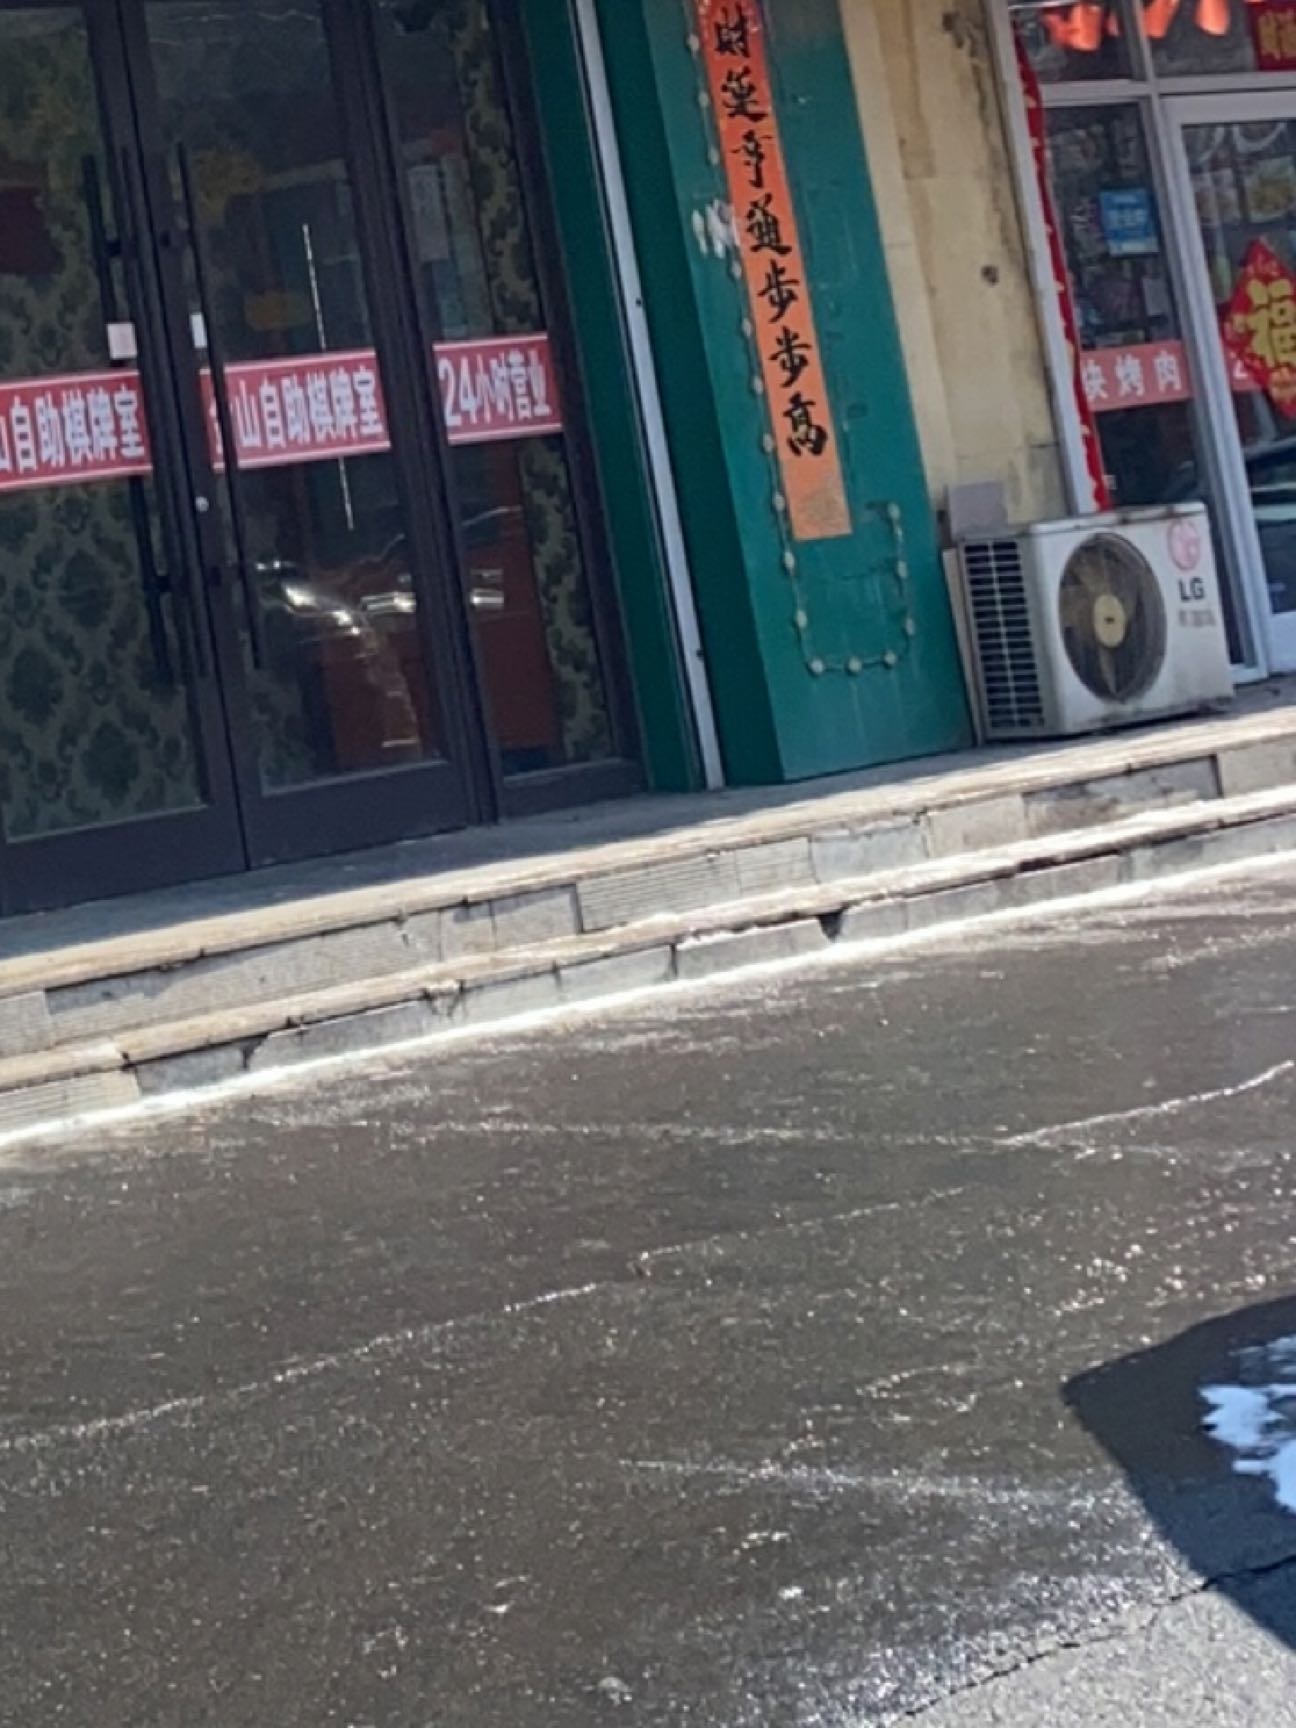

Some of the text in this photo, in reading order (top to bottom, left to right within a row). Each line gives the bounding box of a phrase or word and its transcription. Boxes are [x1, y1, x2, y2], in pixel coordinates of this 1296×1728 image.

[437, 349, 552, 427] 24小时营业
[1178, 577, 1206, 603] LG
